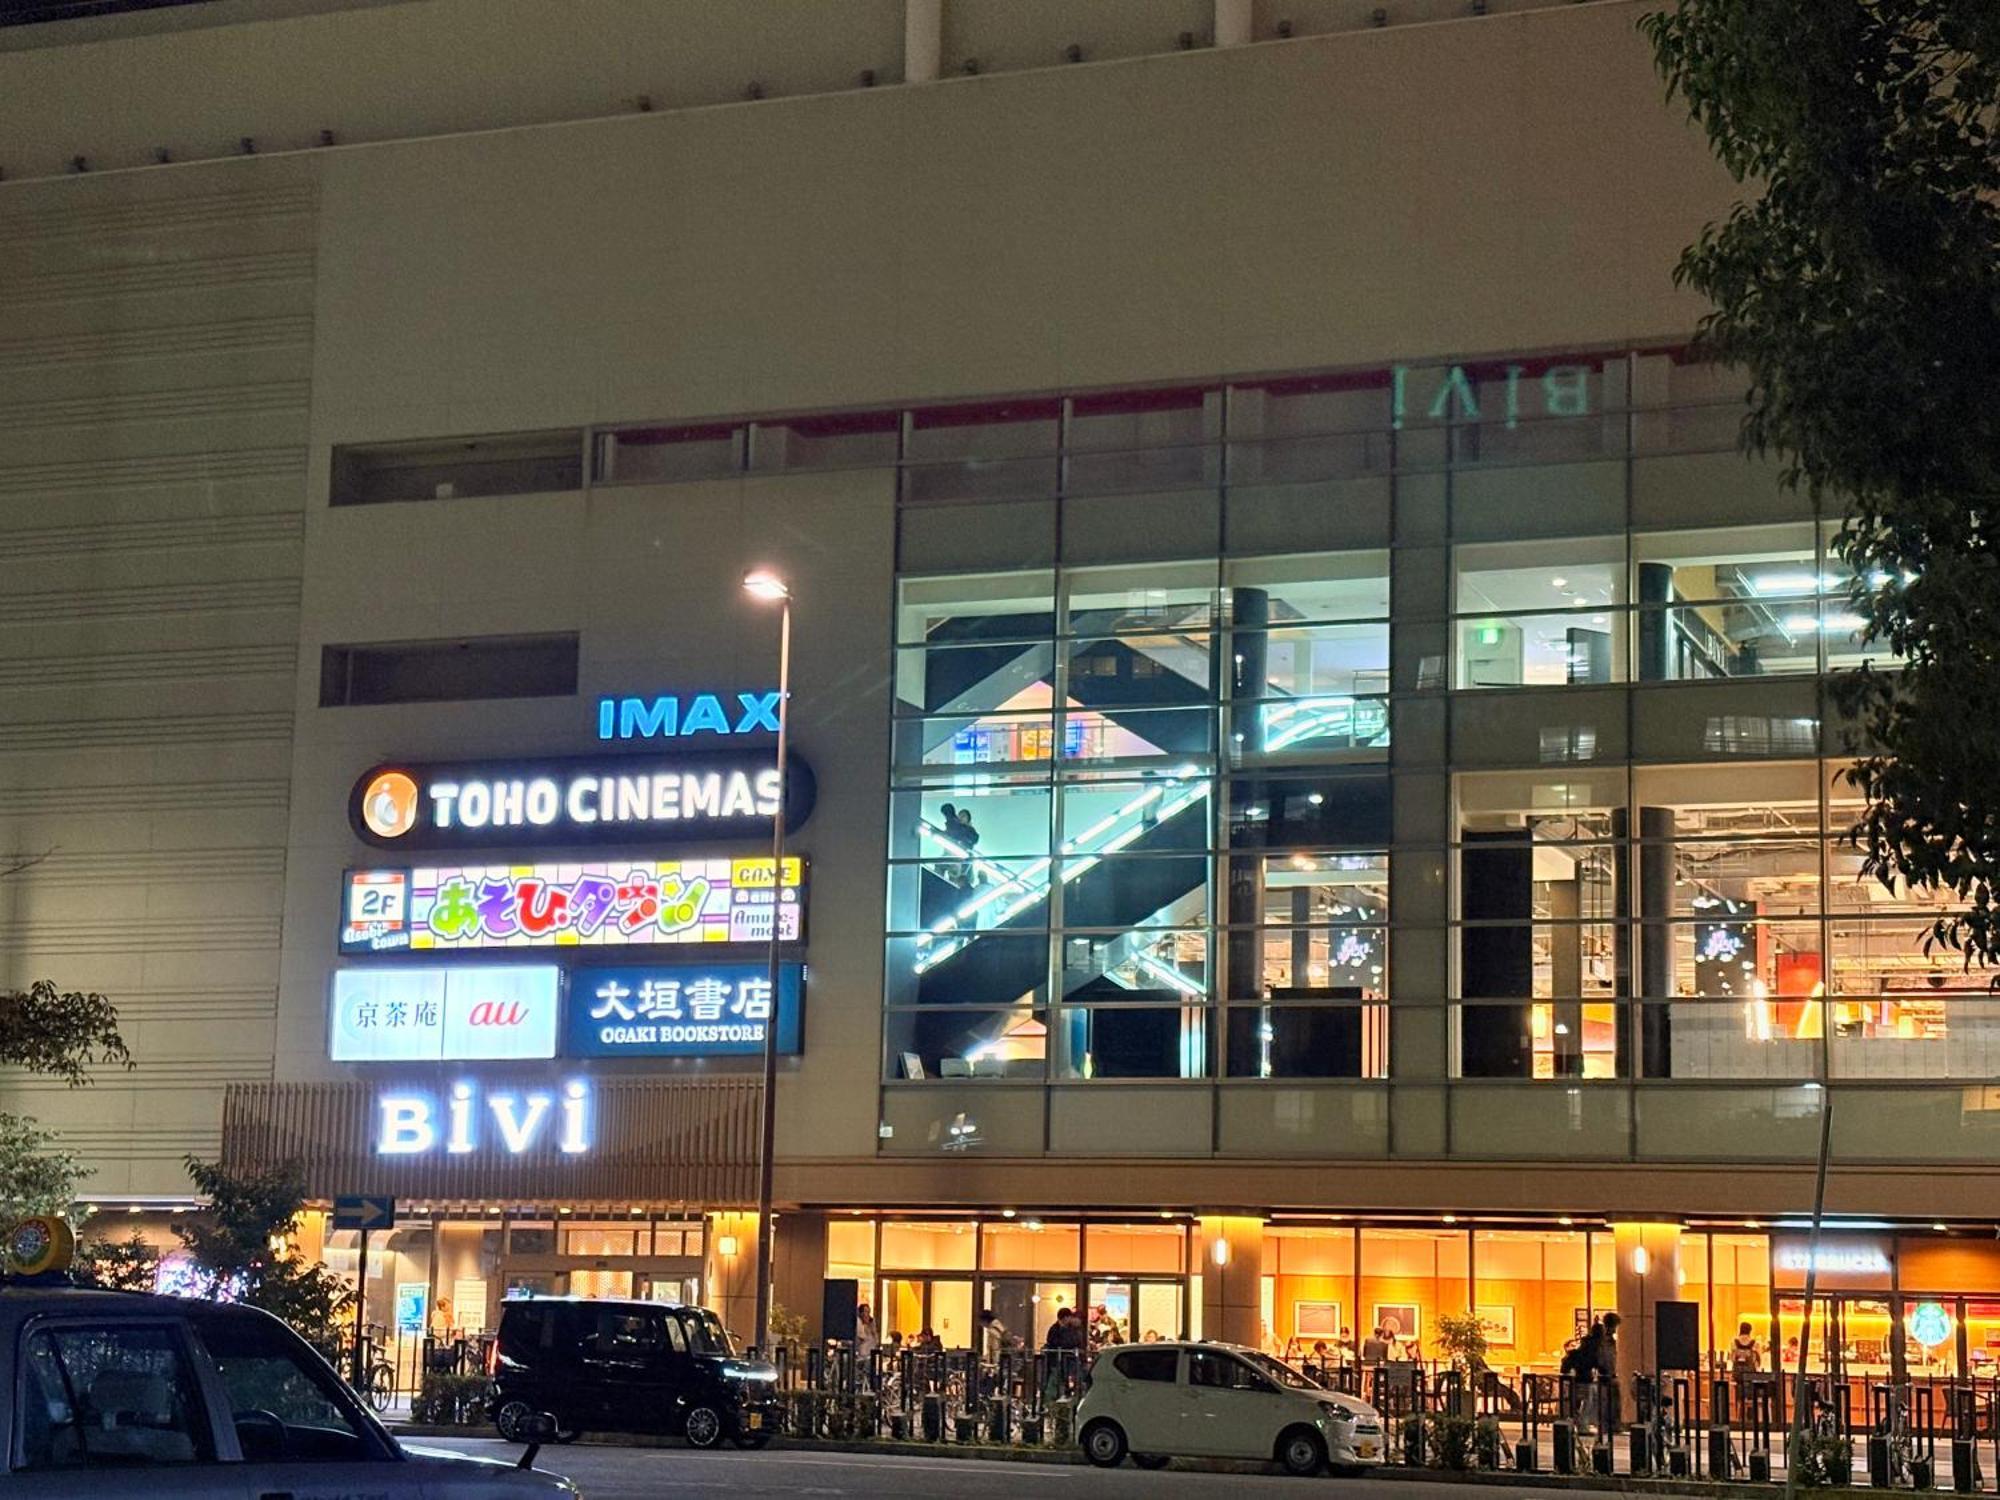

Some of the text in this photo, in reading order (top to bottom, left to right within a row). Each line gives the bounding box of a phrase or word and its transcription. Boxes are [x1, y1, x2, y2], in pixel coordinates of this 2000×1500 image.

[600, 693, 782, 739] IMAX
[430, 769, 782, 828] TOHO CINEMAS
[362, 889, 397, 915] 2F
[431, 874, 711, 937] あそびタウン
[356, 1001, 438, 1028] 京茶庵
[468, 1001, 529, 1026] au
[590, 977, 773, 1021] 大垣書店
[601, 1024, 765, 1044] OGAKI BOOKSTORE
[378, 1083, 588, 1153] BiVi
